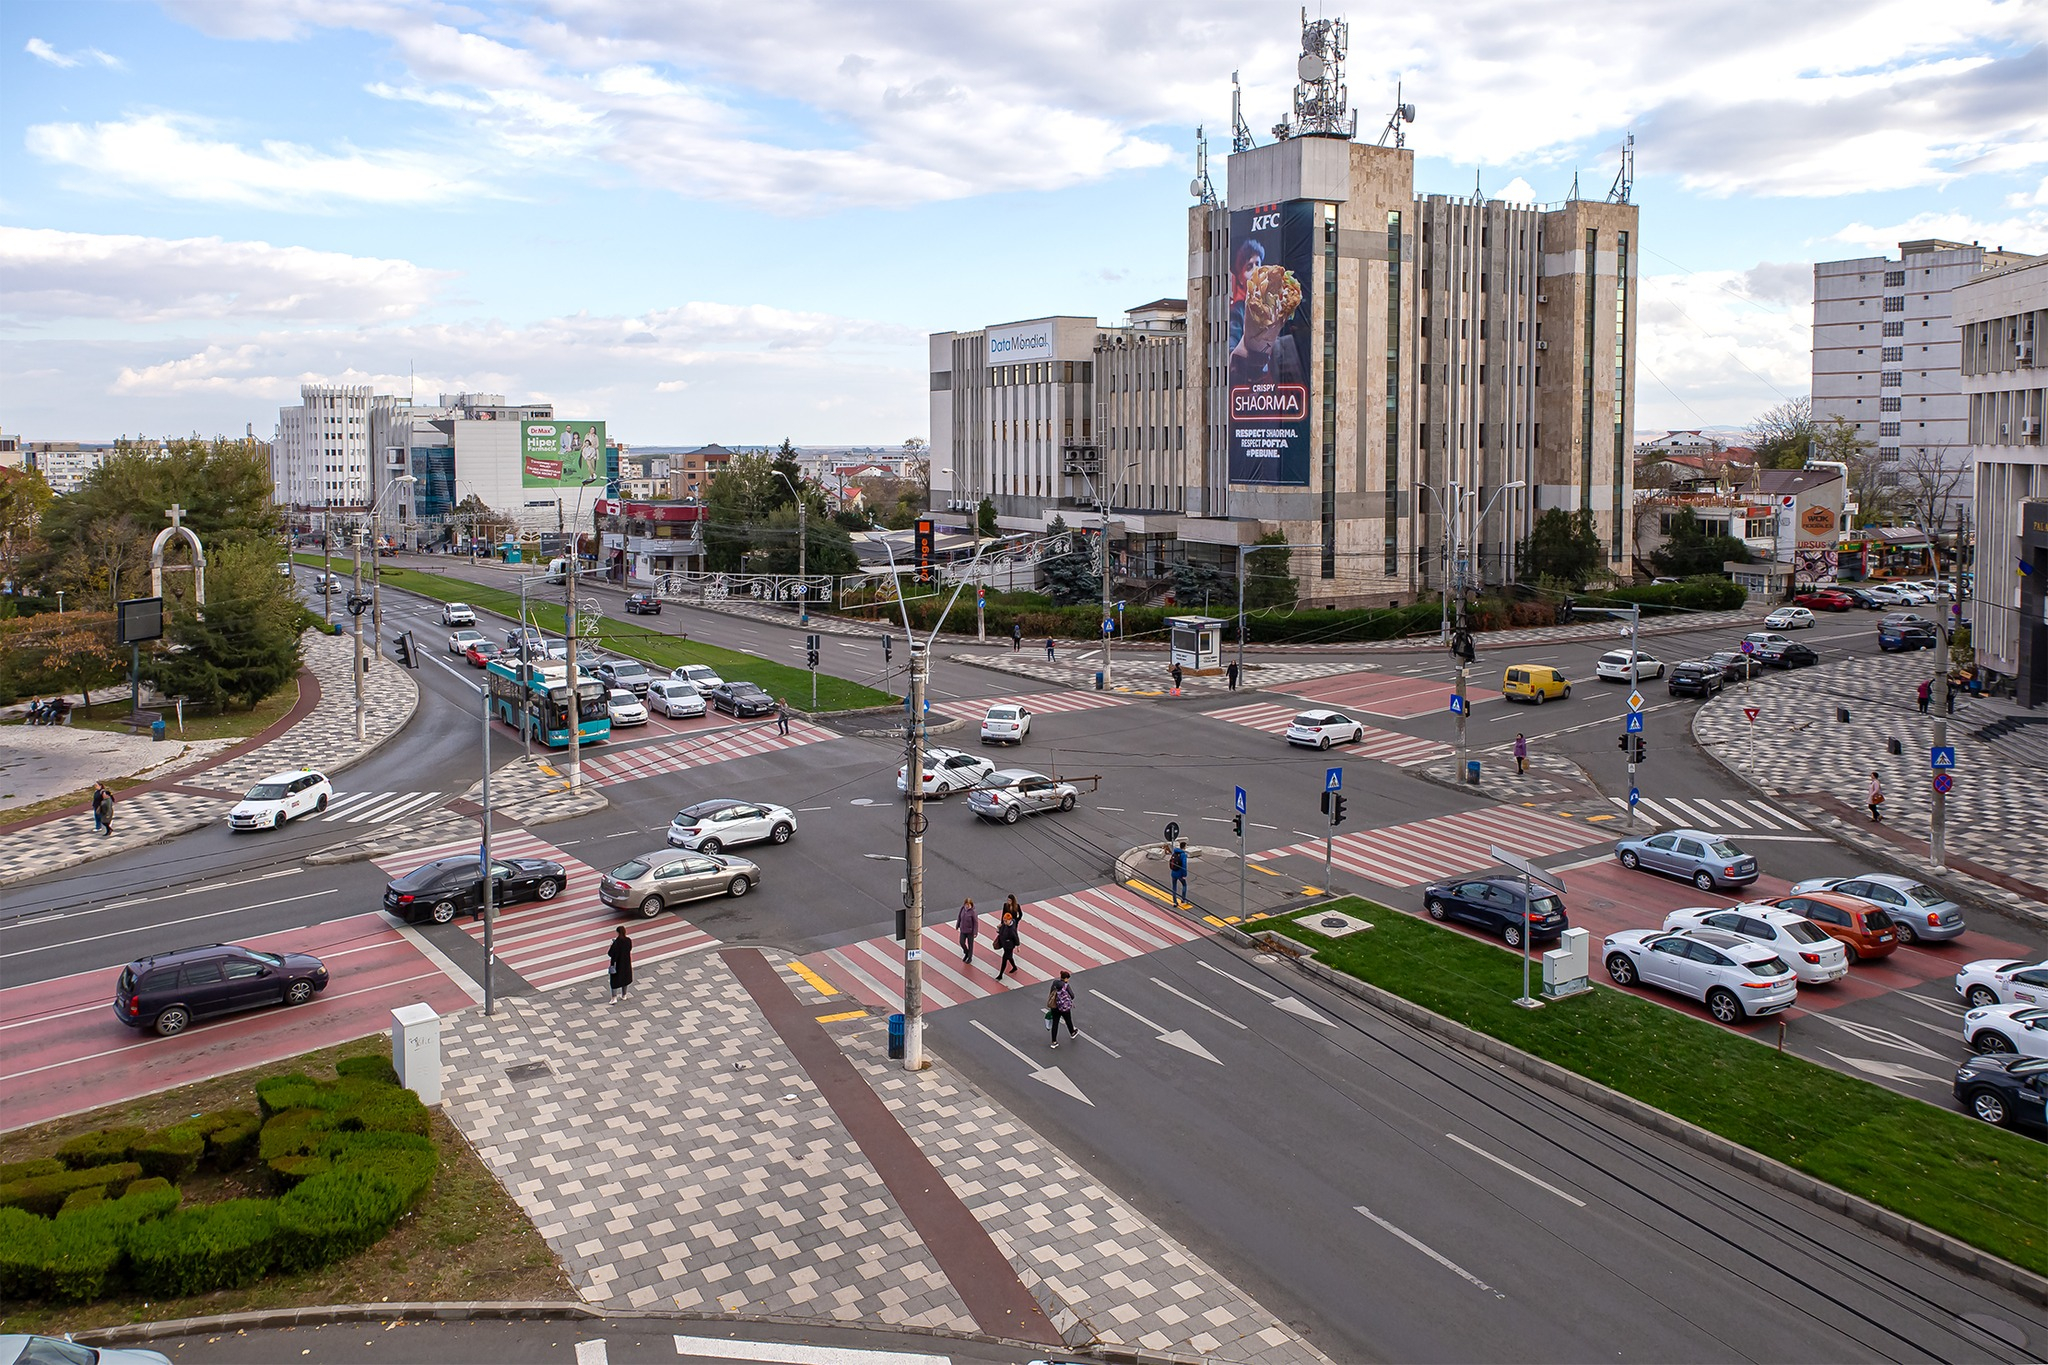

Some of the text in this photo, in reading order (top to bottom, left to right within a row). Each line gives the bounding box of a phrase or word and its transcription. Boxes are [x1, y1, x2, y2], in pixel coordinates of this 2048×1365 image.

[1251, 213, 1280, 232] KFC
[1252, 384, 1275, 392] CRISPY
[1235, 395, 1299, 411] SHAORMA
[1235, 429, 1298, 438] RESPECT SHAORMA.
[527, 437, 557, 447] Hiper
[1241, 439, 1289, 448] RESPECT POFTA
[1246, 449, 1280, 458] #PEBUNE.
[1797, 541, 1827, 549] URSUS
[921, 538, 929, 582] orange
